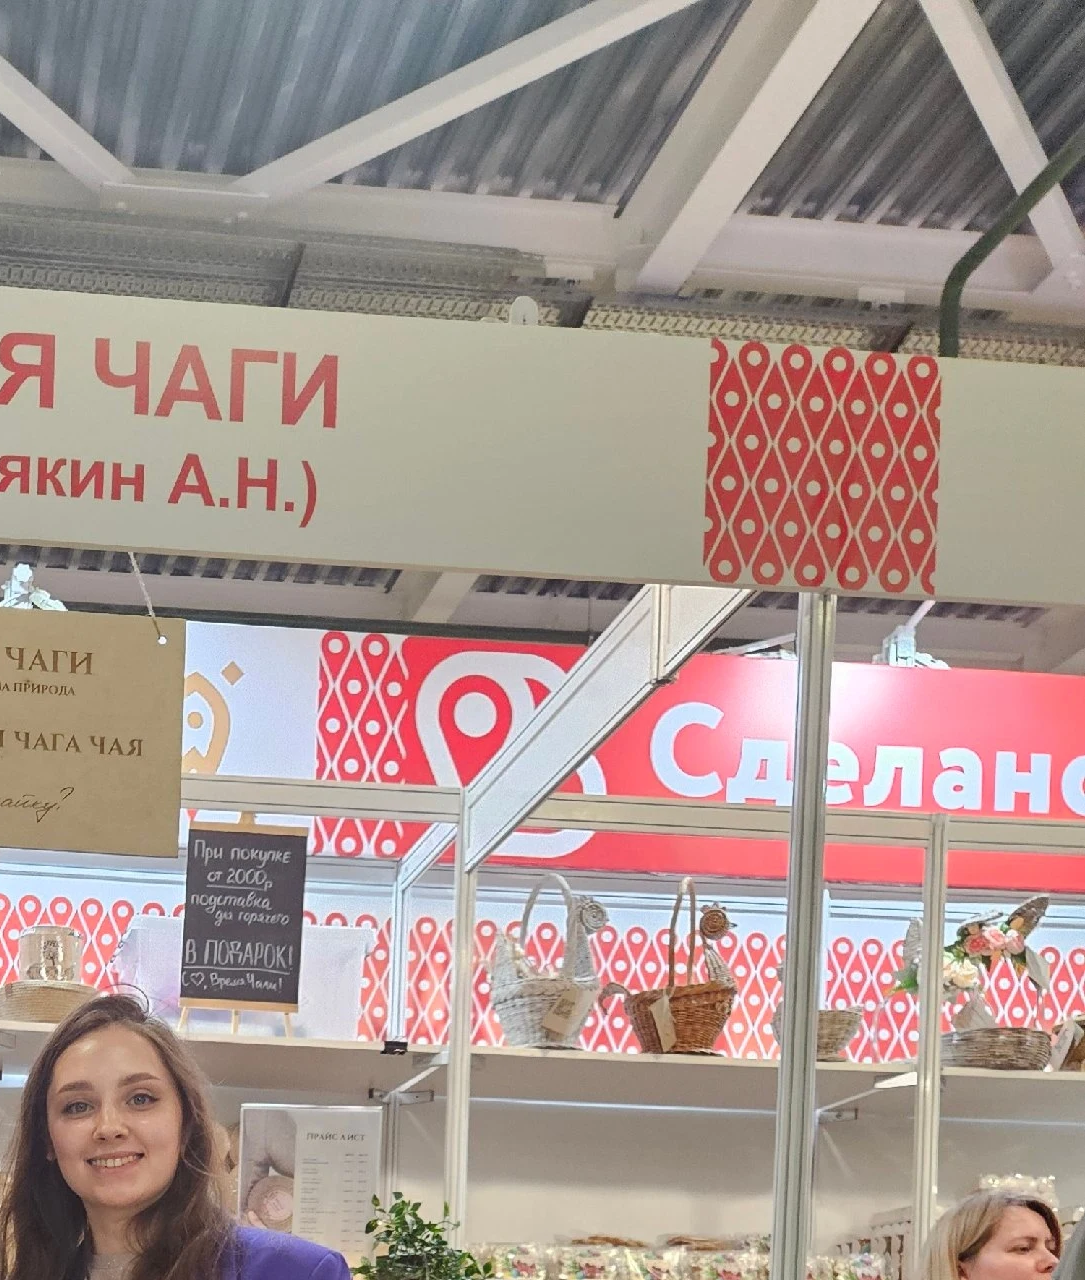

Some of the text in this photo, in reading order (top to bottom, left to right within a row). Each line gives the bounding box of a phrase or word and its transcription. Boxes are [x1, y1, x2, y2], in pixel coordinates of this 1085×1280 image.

[95, 337, 340, 429] ЧАГИ
[168, 453, 318, 528] А.Н.)
[6, 646, 94, 675] ЧАГИ
[13, 681, 76, 697] ПРИРОДА
[14, 730, 80, 754] ЧАГА
[89, 735, 144, 757] ЧАЯ
[194, 839, 291, 868] При покупке
[207, 871, 223, 883] от
[191, 891, 272, 914] подставка
[185, 939, 294, 970] В ПОДАРОК!
